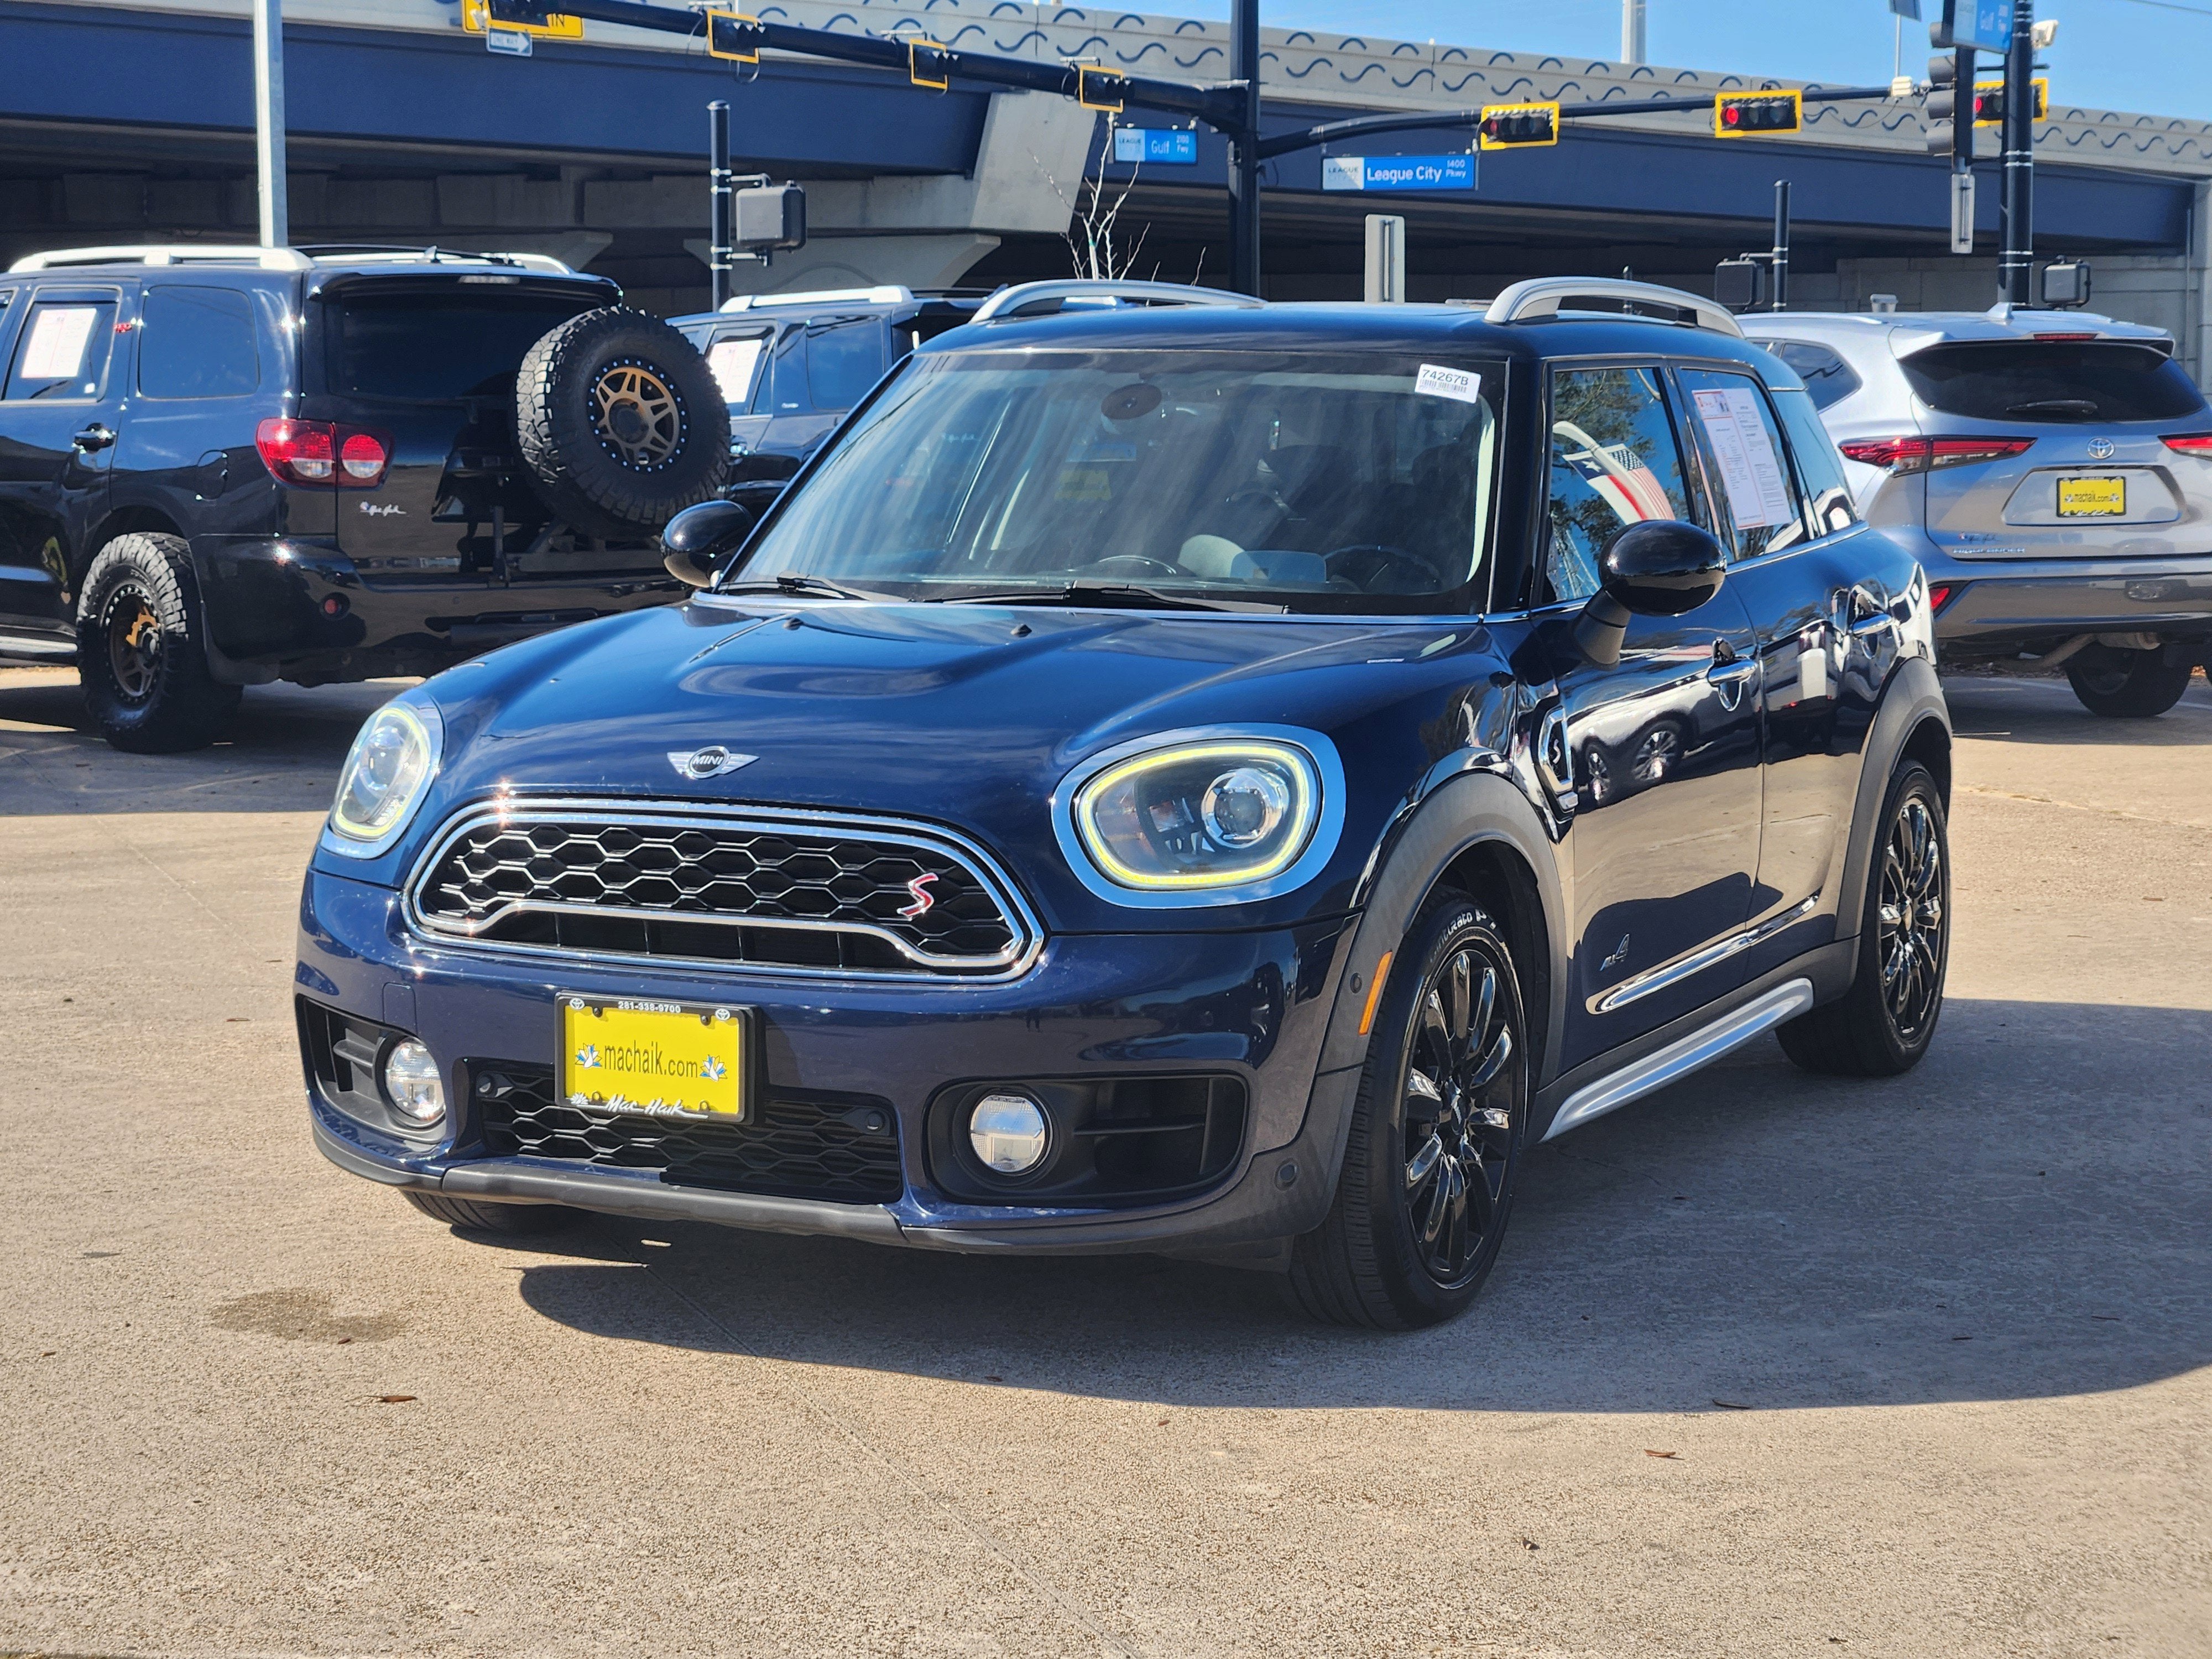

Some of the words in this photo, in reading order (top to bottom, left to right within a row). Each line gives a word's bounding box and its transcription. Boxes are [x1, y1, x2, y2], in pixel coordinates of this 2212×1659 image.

[1151, 139, 1170, 154] Gulf
[1447, 159, 1465, 168] 1400
[1366, 167, 1414, 185] League
[1416, 165, 1443, 183] City
[1446, 169, 1467, 178] Pkwy
[1422, 369, 1469, 386] 74267B
[692, 755, 724, 765] MINI
[896, 872, 940, 918] S
[618, 1000, 681, 1013] 281-338-9700
[604, 1040, 698, 1078] machaik.com
[606, 1093, 644, 1113] Mac
